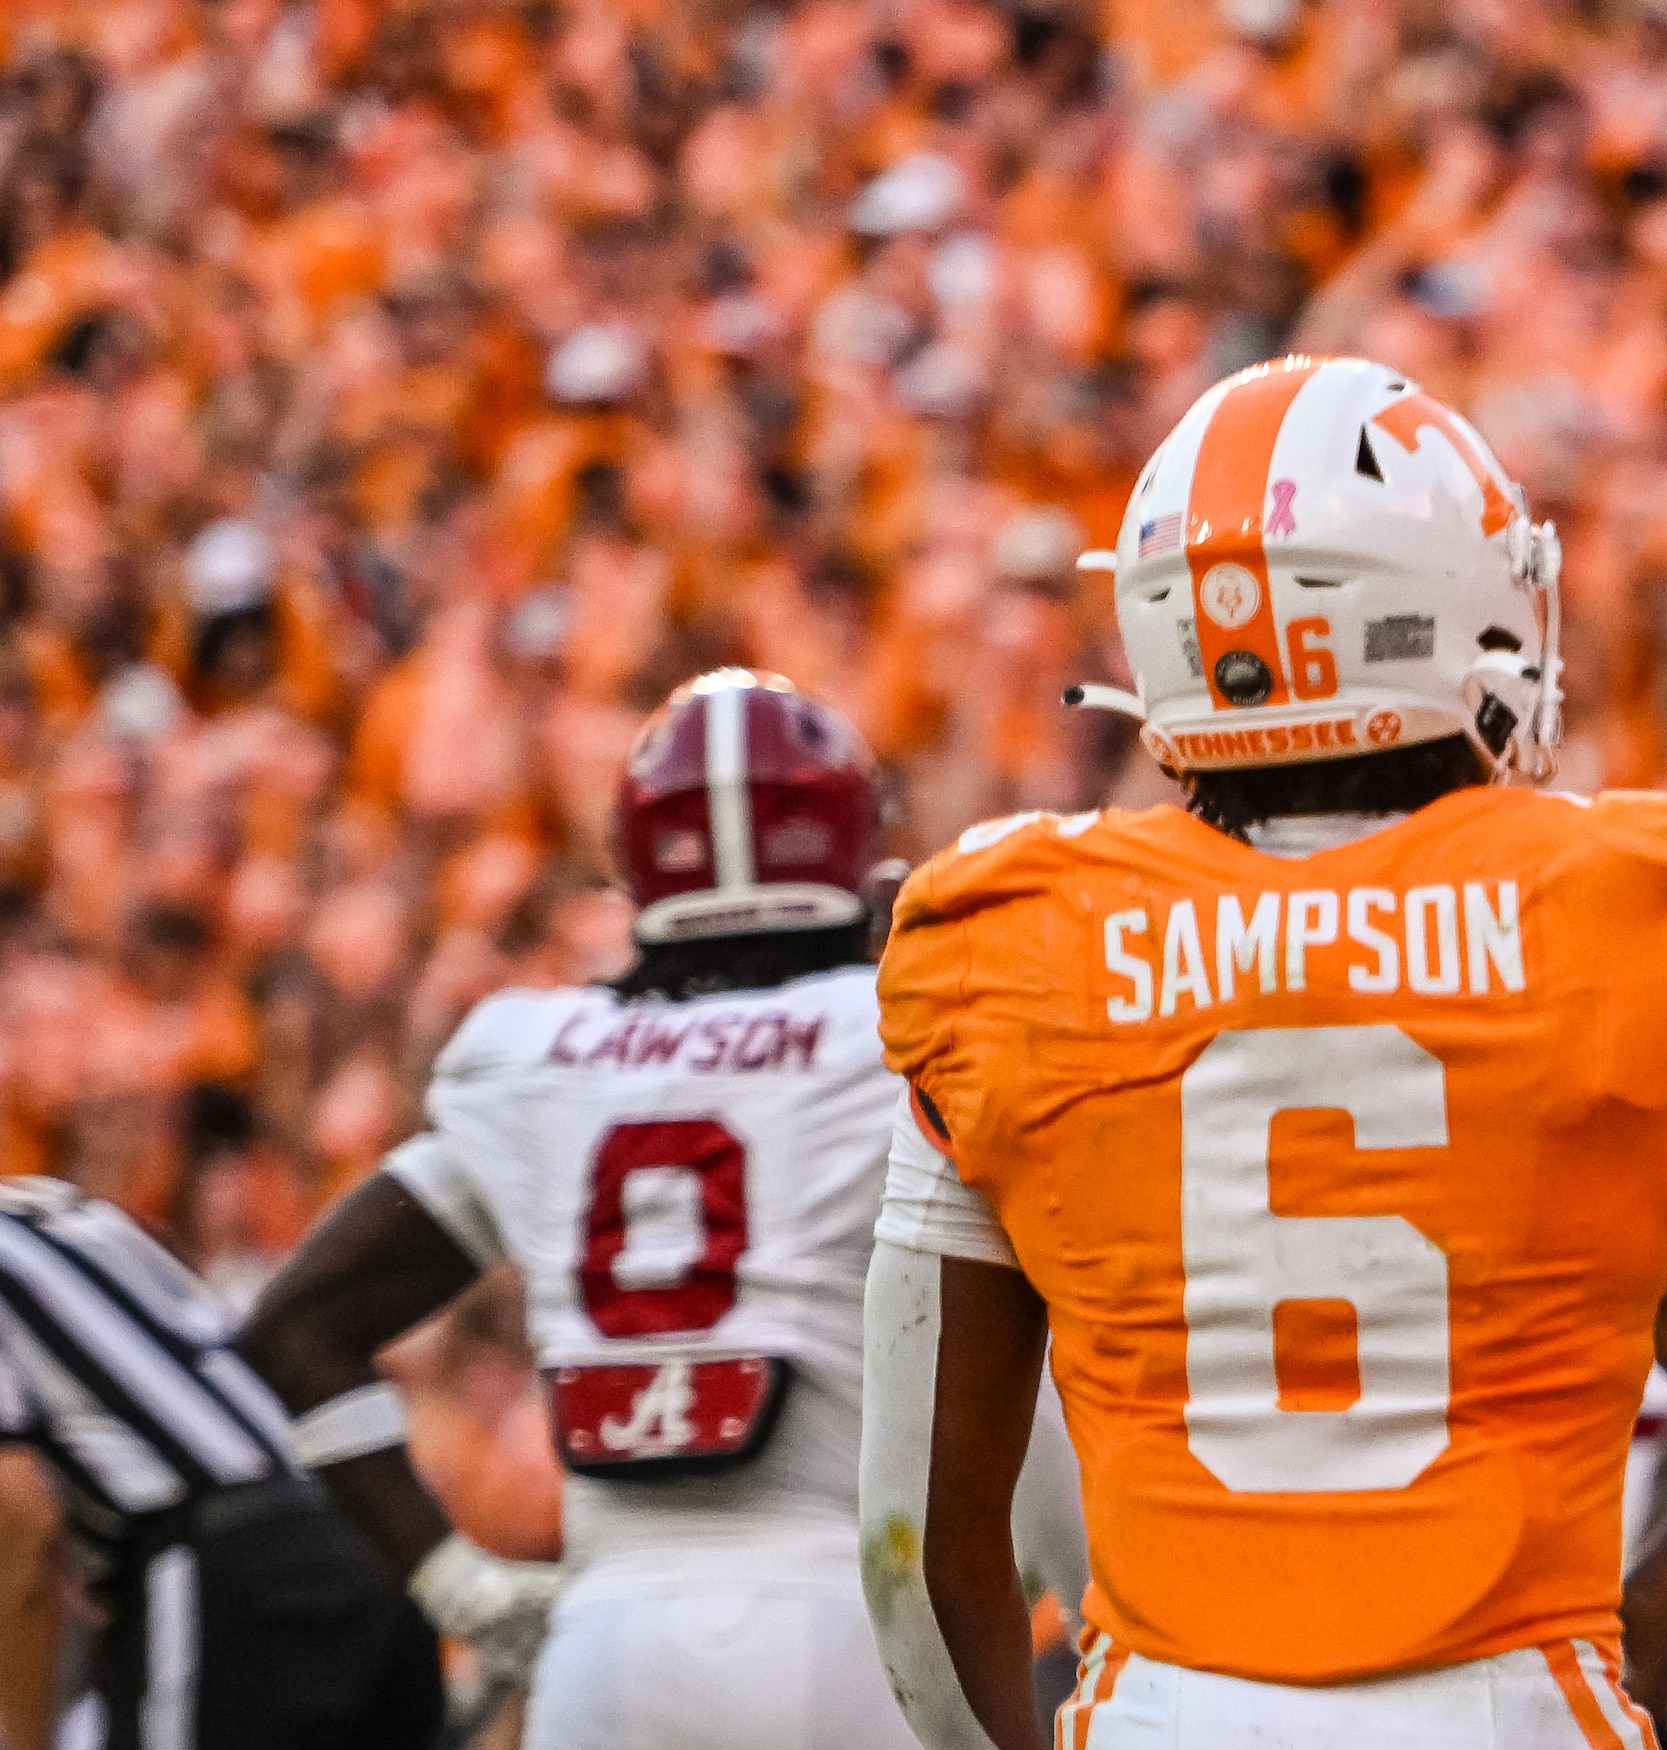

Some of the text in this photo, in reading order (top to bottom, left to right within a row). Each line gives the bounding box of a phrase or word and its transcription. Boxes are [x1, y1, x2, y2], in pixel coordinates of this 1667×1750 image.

[1285, 615, 1339, 701] 6
[1172, 717, 1357, 758] TENNESSEE
[1102, 880, 1527, 1024] SAMPSON
[546, 1008, 828, 1074] LAWSON
[578, 1117, 749, 1338] 0
[1180, 1023, 1451, 1493] 6
[600, 1363, 697, 1455] A
